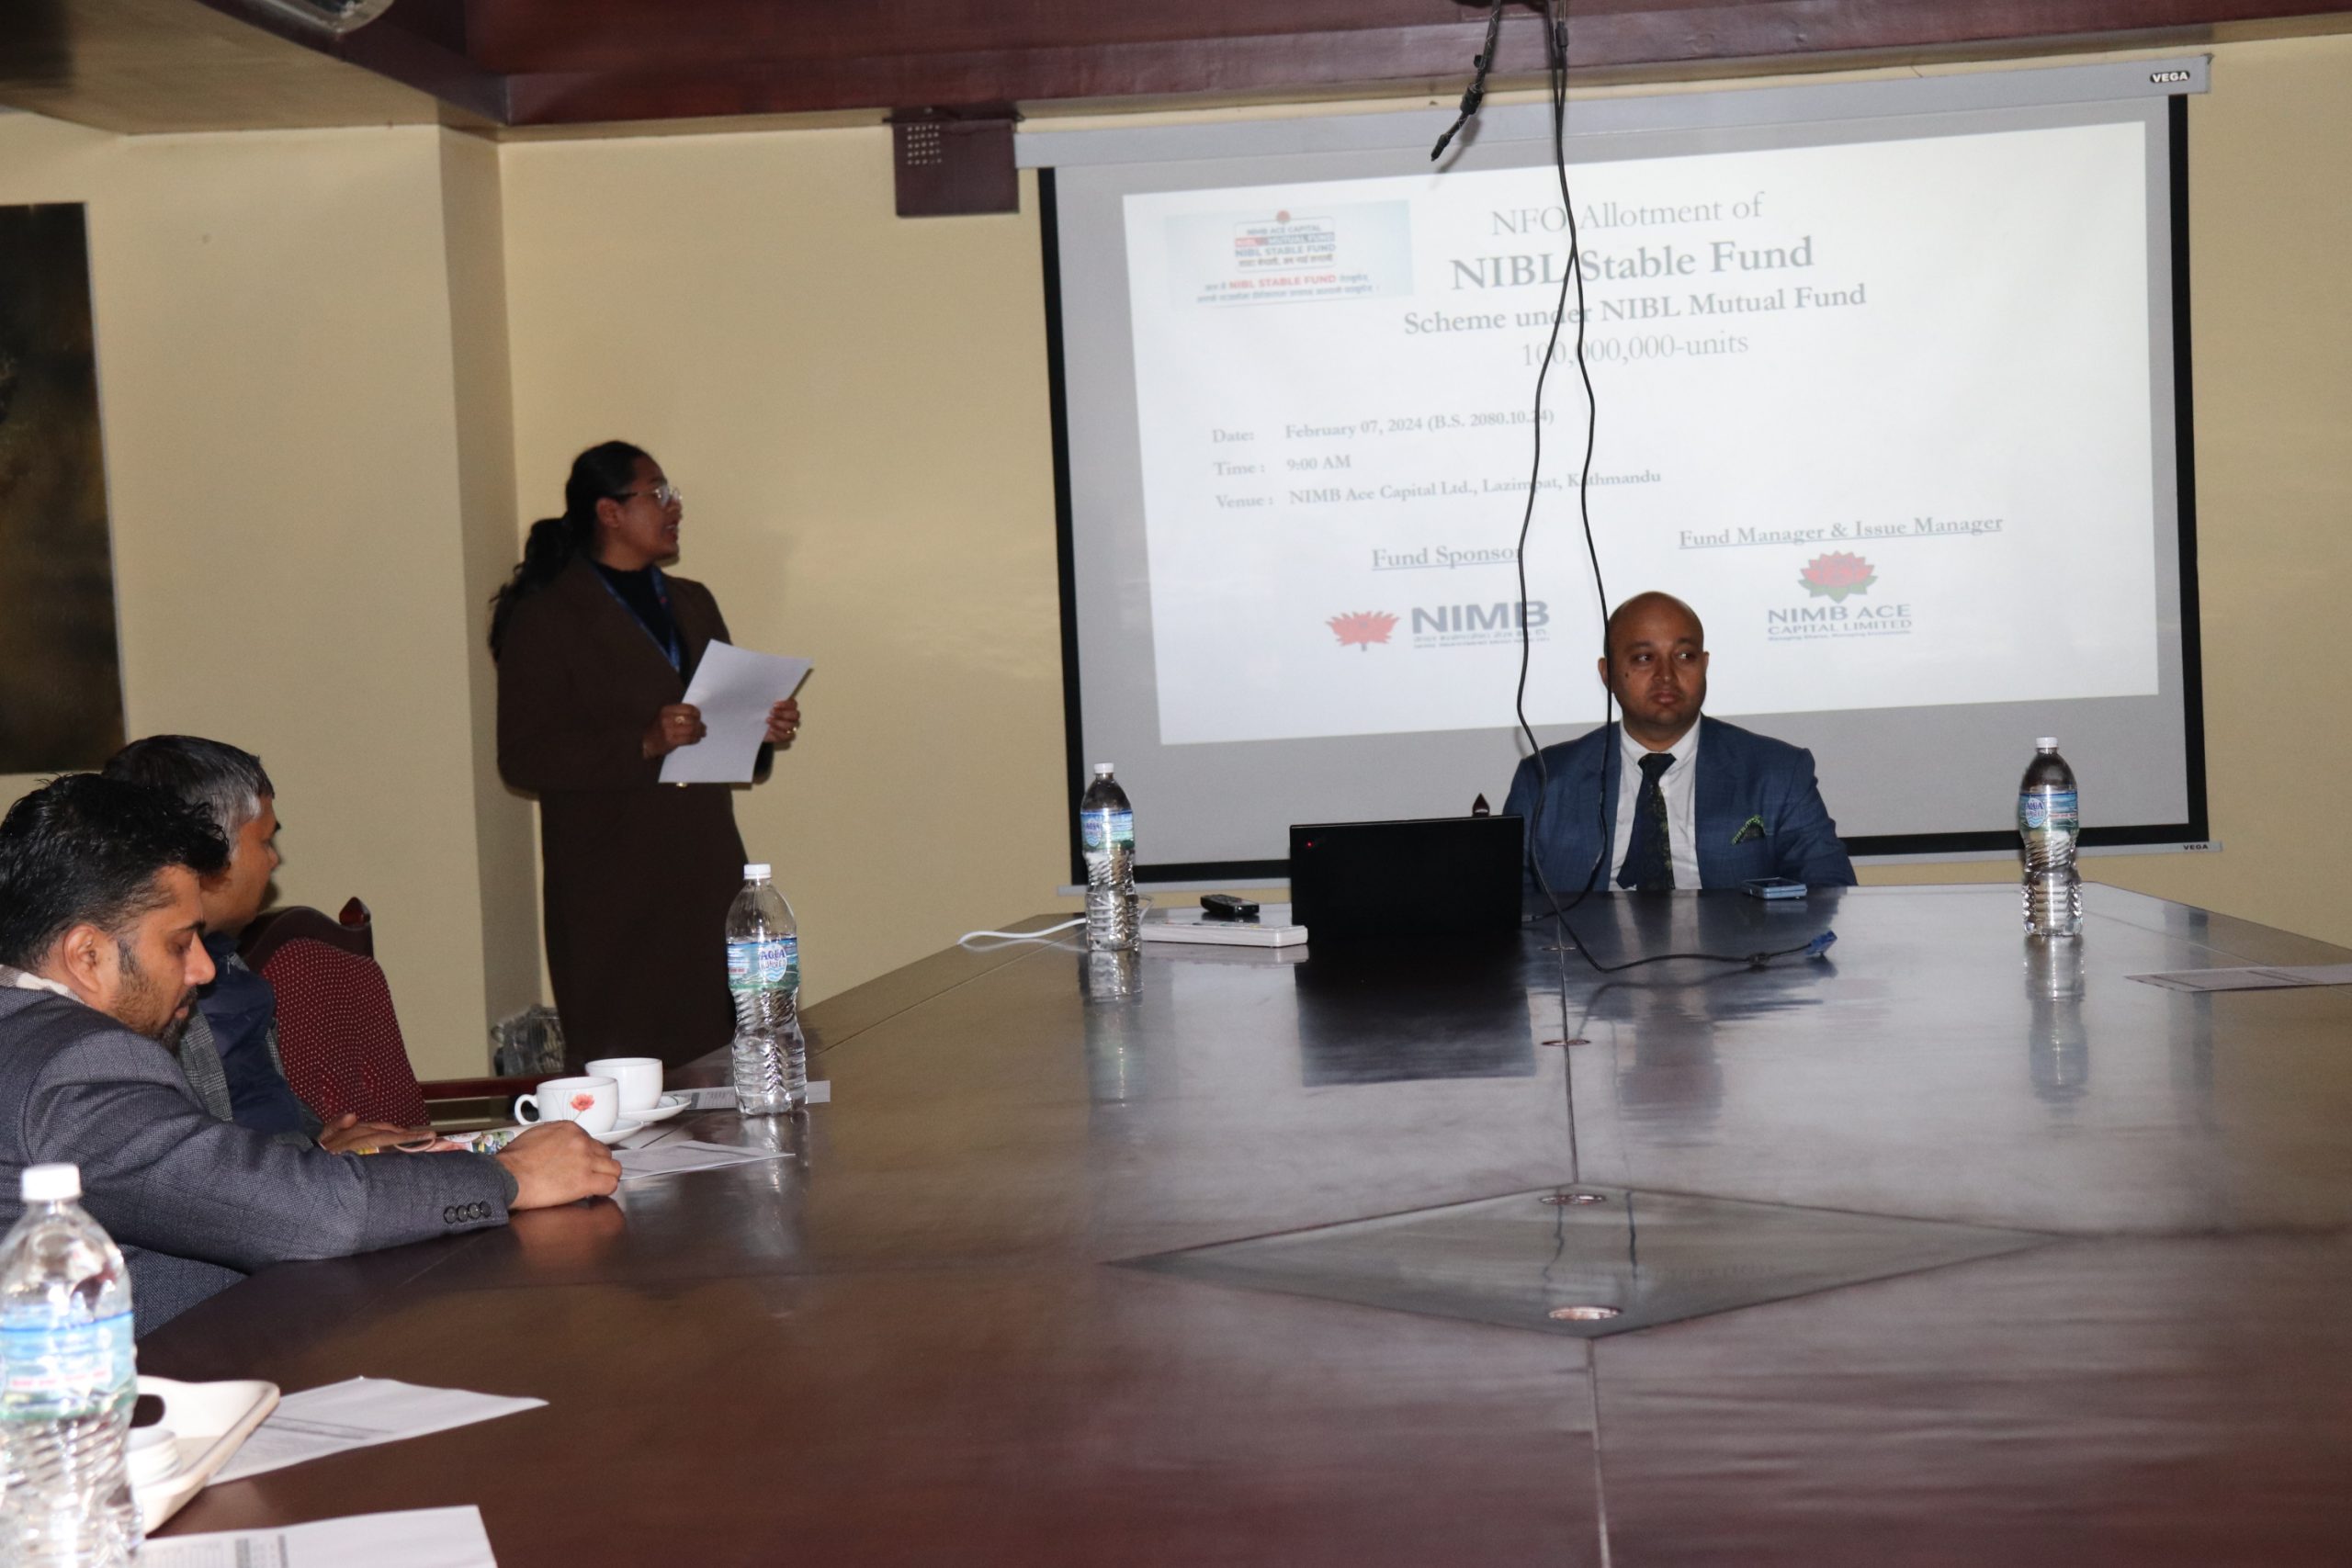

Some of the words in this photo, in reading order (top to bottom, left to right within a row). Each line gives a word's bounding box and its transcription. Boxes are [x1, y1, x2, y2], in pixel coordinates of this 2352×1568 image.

[2152, 72, 2188, 83] VEGA
[1490, 206, 1567, 236] NFO
[1579, 198, 1724, 230] Allotment
[1732, 191, 1765, 219] of
[1265, 245, 1304, 255] STABLE
[1307, 243, 1336, 253] FUND
[1449, 253, 1566, 290] NIBL
[1579, 244, 1696, 282] Stable
[1709, 235, 1815, 274] Fund
[1259, 276, 1301, 288] STABLE
[1305, 274, 1337, 285] FUND
[1404, 310, 1507, 335] Scheme
[1515, 301, 1592, 327] under
[1600, 295, 1681, 321] NIBL
[1689, 288, 1785, 316] Mutual
[1794, 282, 1867, 309] Fund
[1212, 428, 1255, 444] Date:
[1285, 423, 1357, 439] February
[1361, 419, 1385, 435] 07,
[1388, 416, 1423, 433] 2024
[1212, 460, 1256, 477] Time
[1286, 457, 1318, 472] 9:00
[1322, 454, 1351, 470] AM
[1215, 493, 1264, 510] Venue
[1288, 488, 1341, 505] NIMB
[1345, 487, 1375, 502] Ace
[1380, 481, 1436, 502] Capital
[1441, 479, 1478, 496] Ltd.,
[1566, 469, 1662, 488] Kthmandu
[1679, 527, 1731, 547] Fund
[1736, 525, 1825, 546] Manager
[1830, 522, 1849, 538] &
[1855, 519, 1907, 537] Issue
[1913, 516, 2004, 535] Manager
[1372, 547, 1430, 569] Fund
[1435, 545, 1523, 570] Sponso
[1411, 601, 1550, 634] NIMB
[1768, 605, 1848, 624] NIMB
[1857, 604, 1912, 619] ACE
[1768, 623, 1838, 635] CAPITAL
[1844, 619, 1912, 632] LIMITED
[761, 949, 786, 961] AQUA
